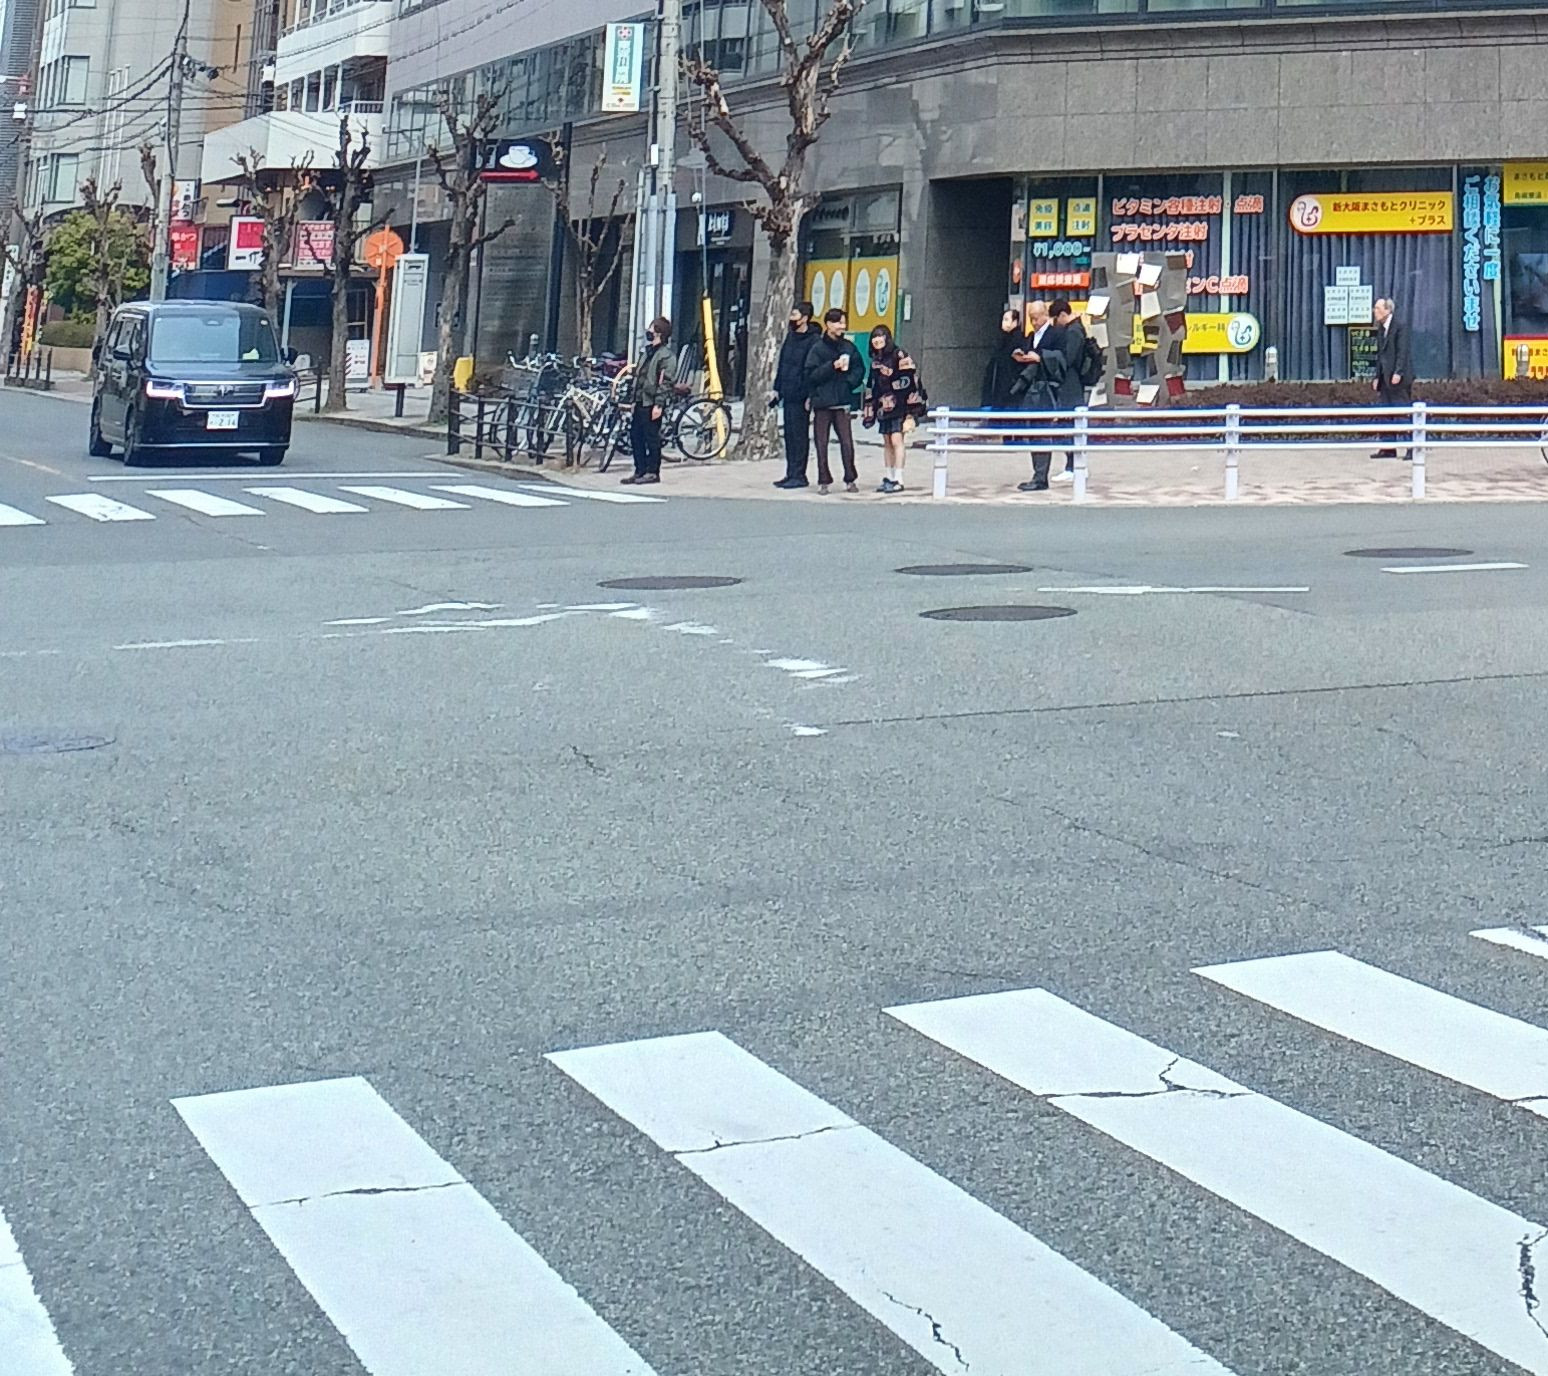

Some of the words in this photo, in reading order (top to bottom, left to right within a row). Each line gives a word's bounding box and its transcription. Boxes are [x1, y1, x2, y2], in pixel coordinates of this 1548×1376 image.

[1332, 200, 1446, 212] 新大阪まさもとクリニック
[1483, 176, 1501, 280] お気軽に一度
